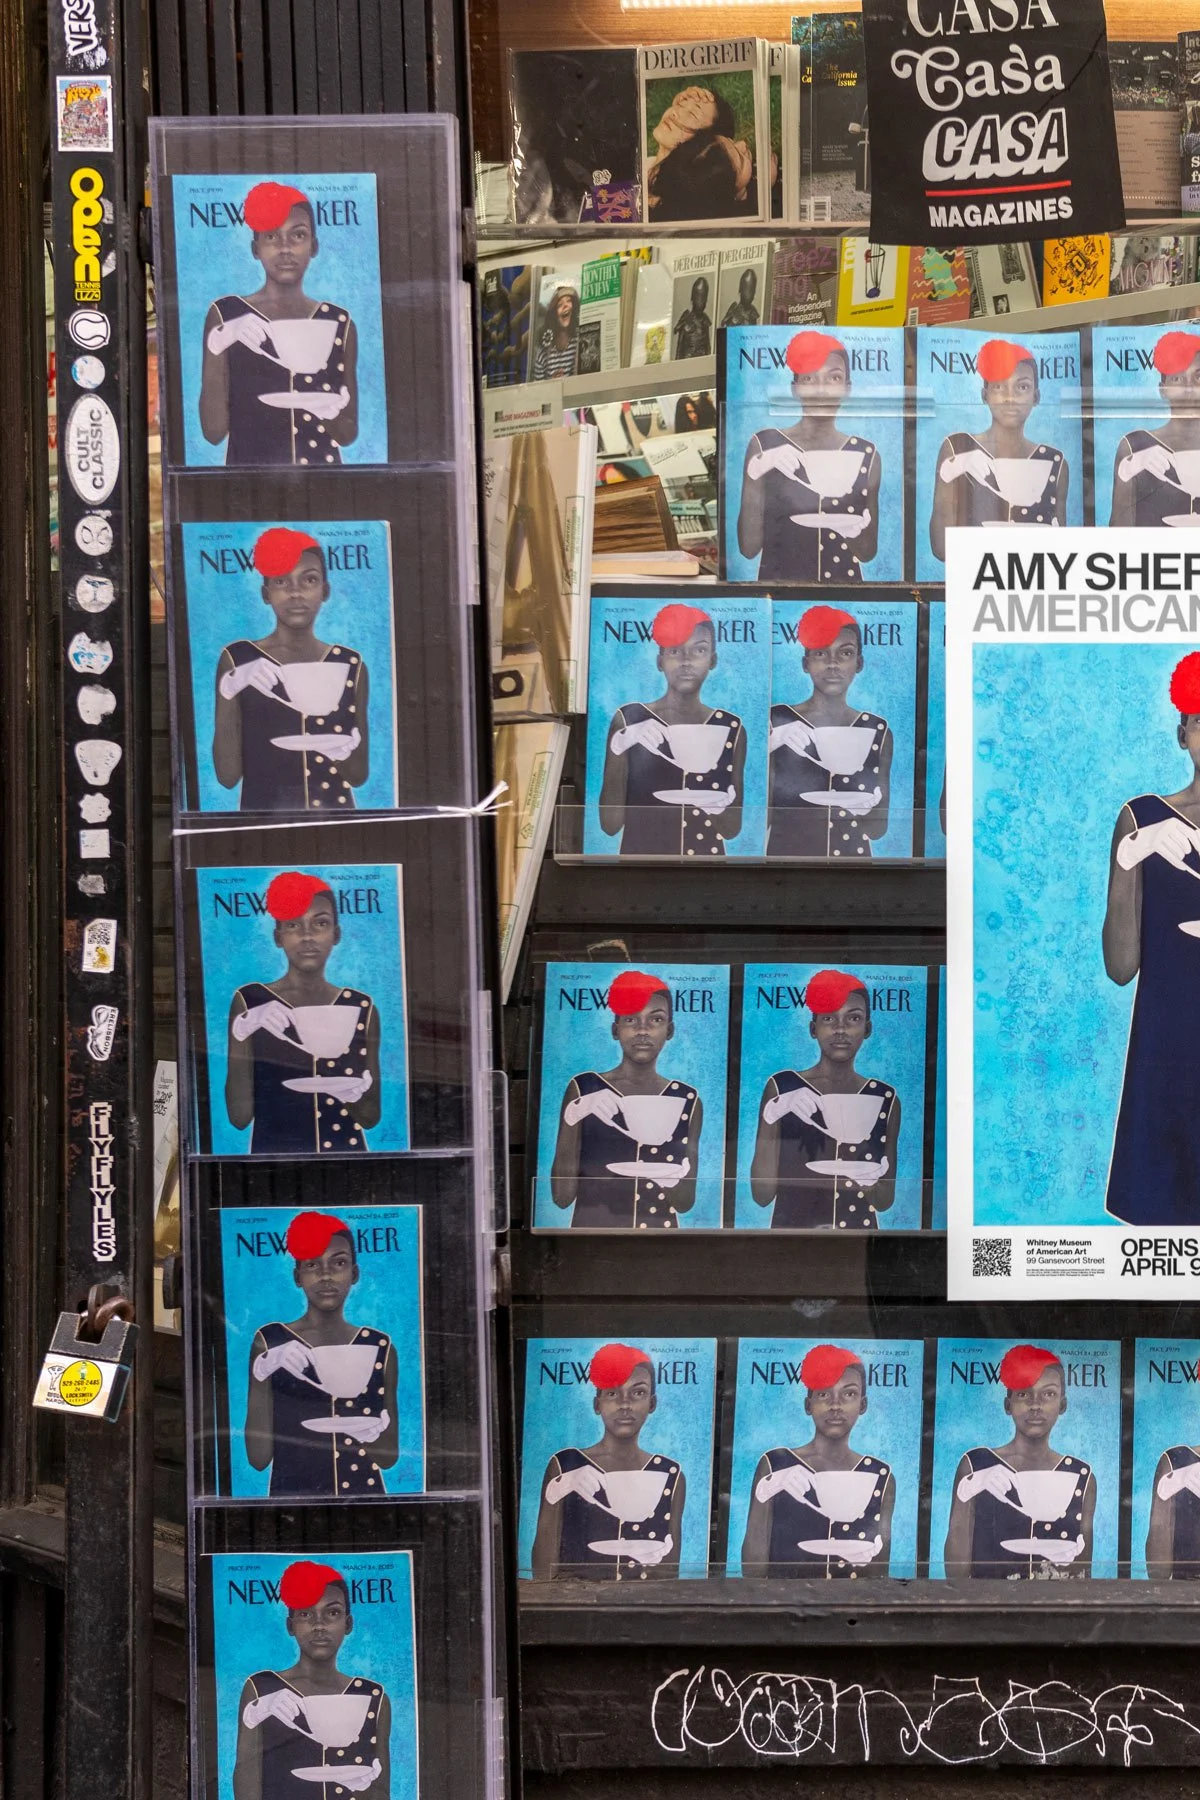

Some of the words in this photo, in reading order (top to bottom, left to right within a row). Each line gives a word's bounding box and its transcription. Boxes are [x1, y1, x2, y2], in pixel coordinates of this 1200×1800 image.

[907, 0, 1061, 37] CASA
[644, 47, 688, 71] DER
[691, 40, 752, 66] GREIF
[922, 107, 1069, 182] CASA
[190, 202, 245, 228] NEW
[316, 200, 361, 227] KER
[928, 196, 1074, 228] MAGAZINES
[583, 264, 617, 284] MONTHLY
[583, 281, 611, 298] REVIEW
[807, 292, 818, 301] An
[788, 299, 832, 313] independent
[788, 311, 823, 324] magazine
[739, 347, 786, 371] NEW
[851, 348, 891, 372] KER
[930, 350, 977, 374] NEW
[1039, 355, 1078, 380] KER
[1106, 347, 1154, 372] NEW
[78, 425, 90, 473] CULT
[91, 407, 105, 490] CLASSIC
[199, 549, 255, 575] NEW
[328, 544, 373, 571] KER
[972, 553, 1078, 590] AMY
[603, 620, 653, 644] NEW
[717, 620, 758, 645] KER
[771, 622, 800, 645] EW
[864, 623, 904, 647] KER
[213, 893, 266, 918] NEW
[339, 888, 383, 914] KER
[559, 988, 609, 1011] NEW
[675, 989, 715, 1013] KER
[757, 986, 807, 1009] NEW
[872, 988, 912, 1012] KER
[236, 1232, 287, 1258] NEW
[357, 1227, 401, 1254] KER
[1026, 1239, 1058, 1247] Whitney
[1120, 1238, 1199, 1258] OPENS
[1120, 1257, 1186, 1277] APRIL
[539, 1361, 590, 1385] NEW
[657, 1361, 699, 1385] KER
[750, 1361, 802, 1385] NEW
[867, 1363, 909, 1388] KER
[951, 1360, 1001, 1385] NEW
[1067, 1363, 1109, 1388] KER
[1148, 1360, 1199, 1384] NEW
[228, 1580, 282, 1605] NEW
[351, 1577, 396, 1604] KER
